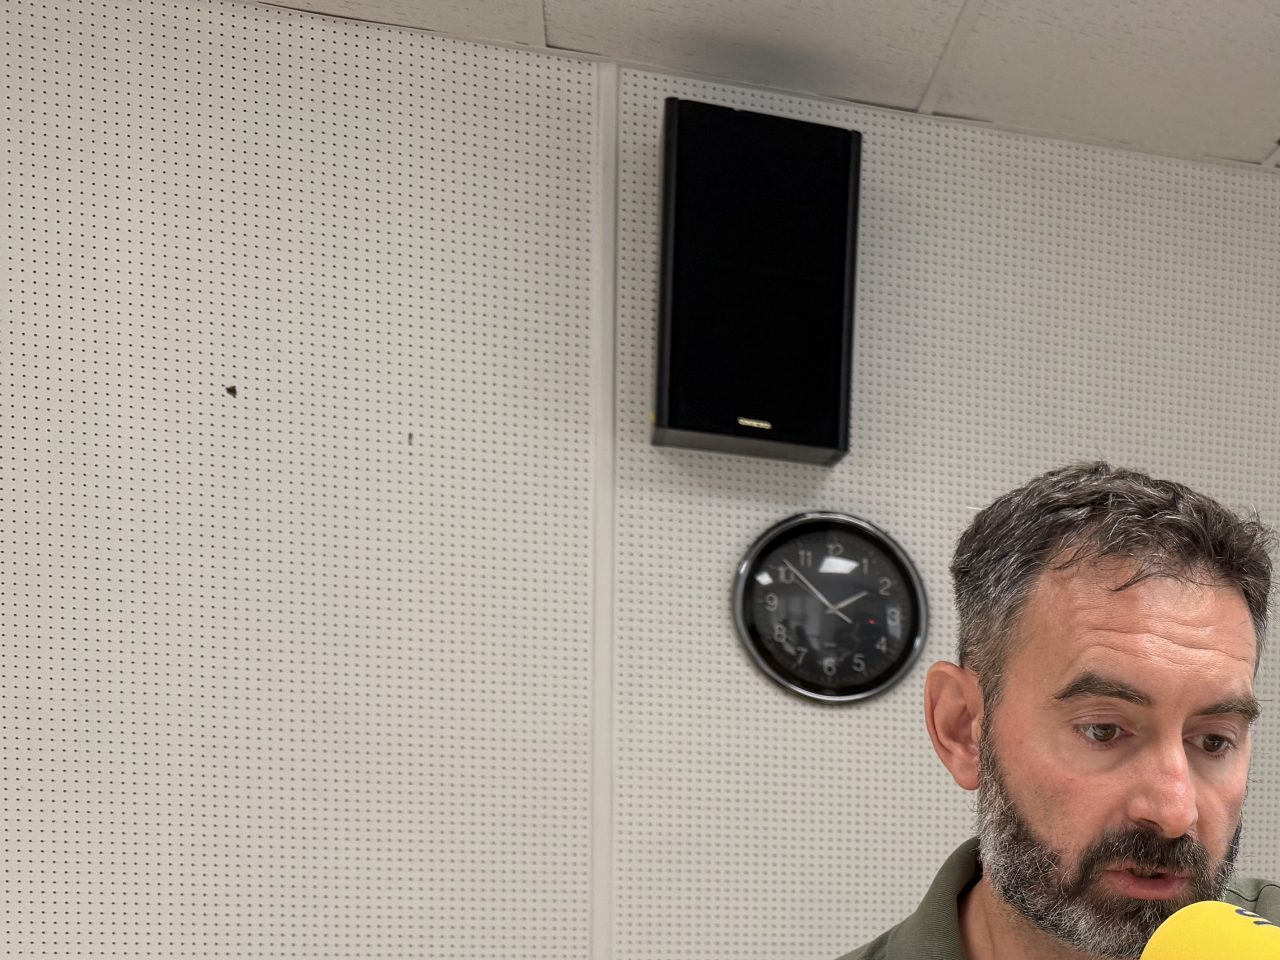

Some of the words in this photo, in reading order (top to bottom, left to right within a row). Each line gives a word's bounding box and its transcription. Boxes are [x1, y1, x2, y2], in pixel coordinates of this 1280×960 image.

[799, 550, 813, 568] 11
[862, 558, 869, 575] 1
[777, 565, 795, 584] 10
[878, 577, 893, 596] 2
[764, 592, 779, 612] 9
[887, 607, 900, 626] 3
[773, 623, 787, 643] 8
[875, 636, 888, 654] 4
[796, 647, 809, 666] 7
[822, 656, 837, 676] 6
[852, 653, 866, 673] 5
